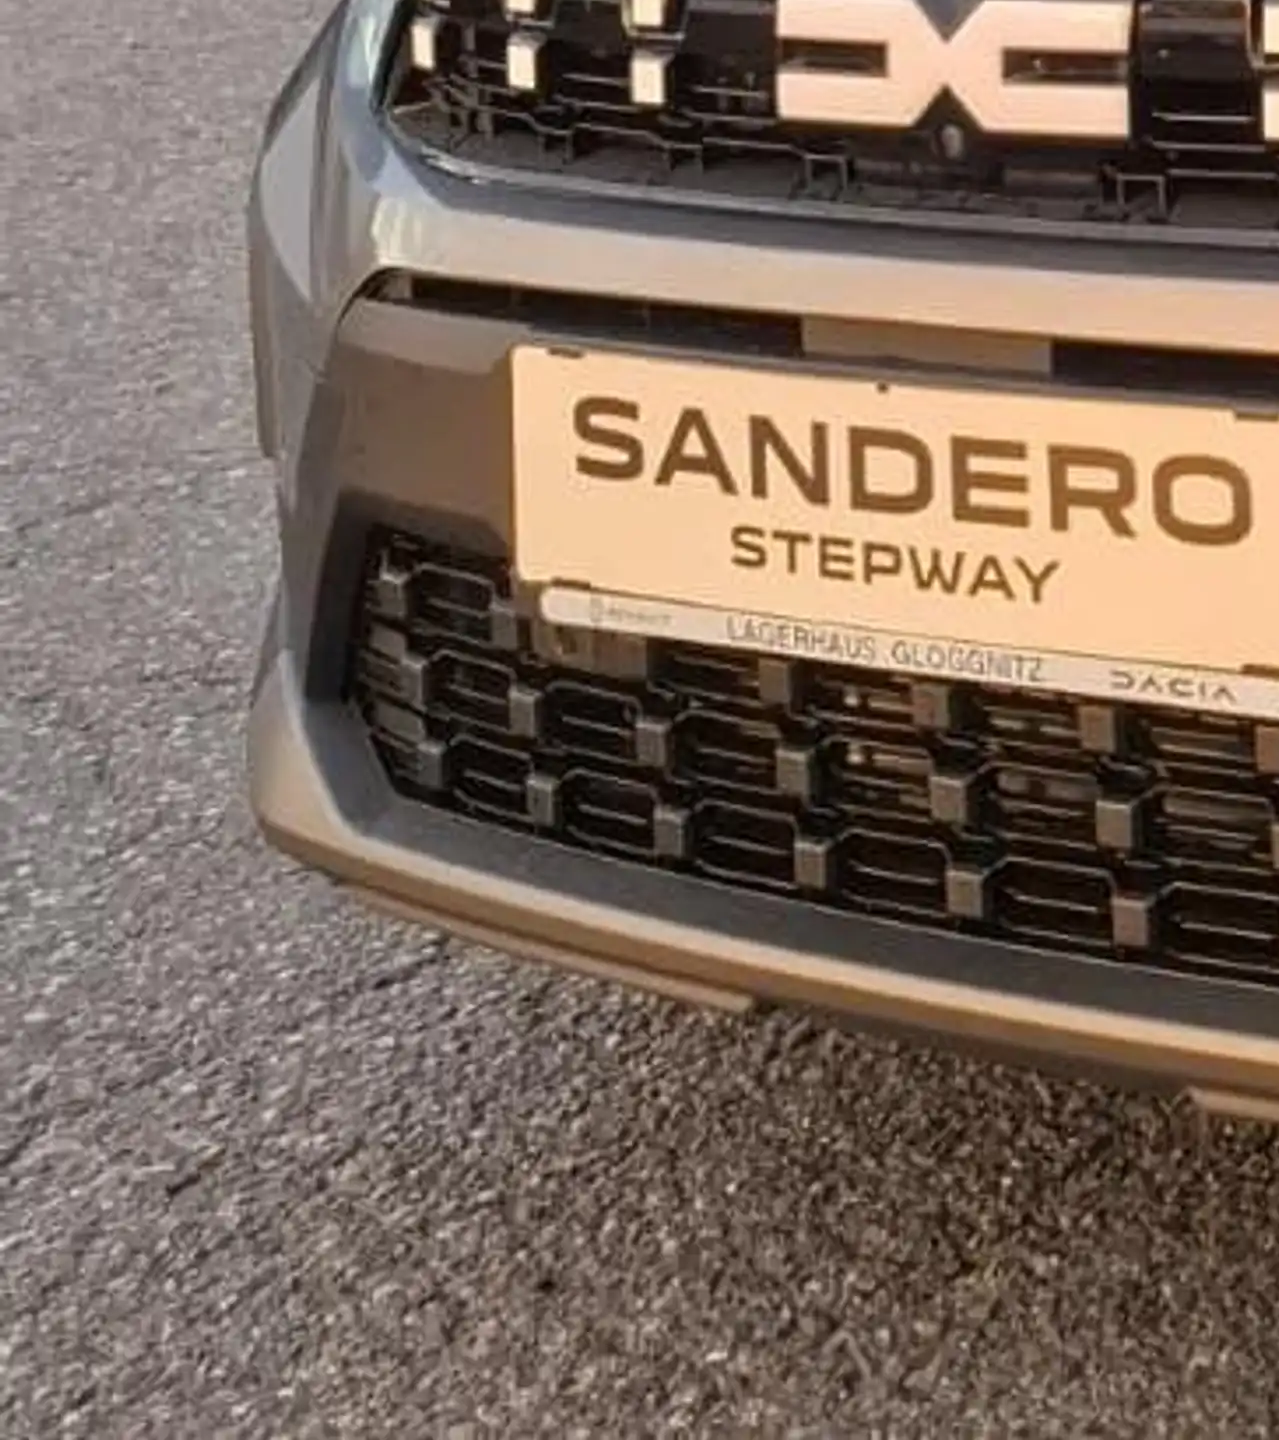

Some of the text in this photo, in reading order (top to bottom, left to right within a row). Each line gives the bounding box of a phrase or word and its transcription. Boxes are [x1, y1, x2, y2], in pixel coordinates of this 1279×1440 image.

[572, 395, 1253, 547] SANDERO
[730, 525, 1060, 606] STEPWAY
[726, 615, 877, 659] LAGERHAUS
